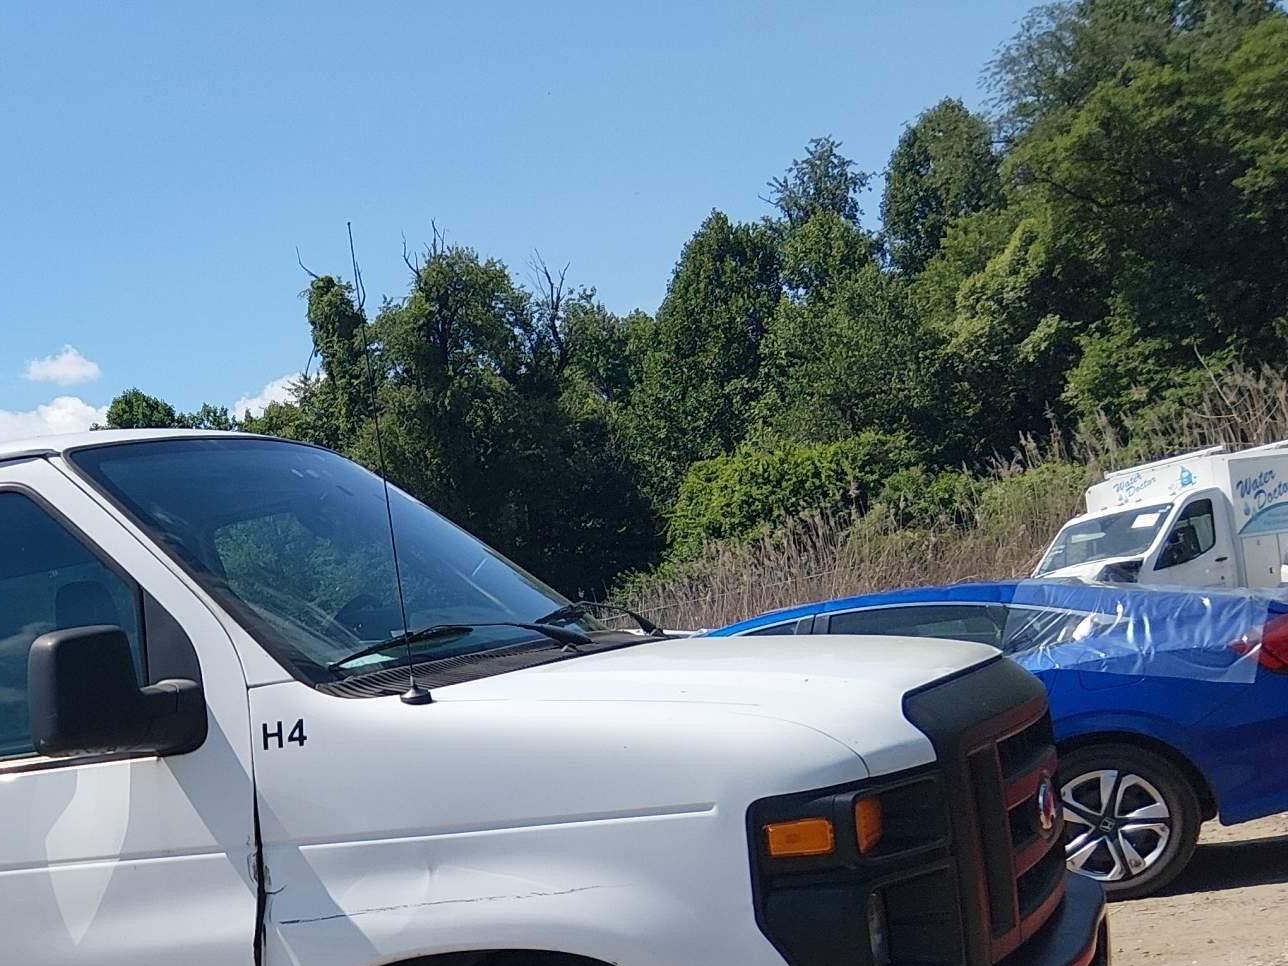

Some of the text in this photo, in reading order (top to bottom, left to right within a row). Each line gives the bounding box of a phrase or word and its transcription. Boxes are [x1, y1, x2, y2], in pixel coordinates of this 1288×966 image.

[1113, 473, 1142, 492] Water
[1126, 477, 1156, 496] Doctor
[1236, 470, 1275, 498] Water
[262, 718, 308, 751] H4
